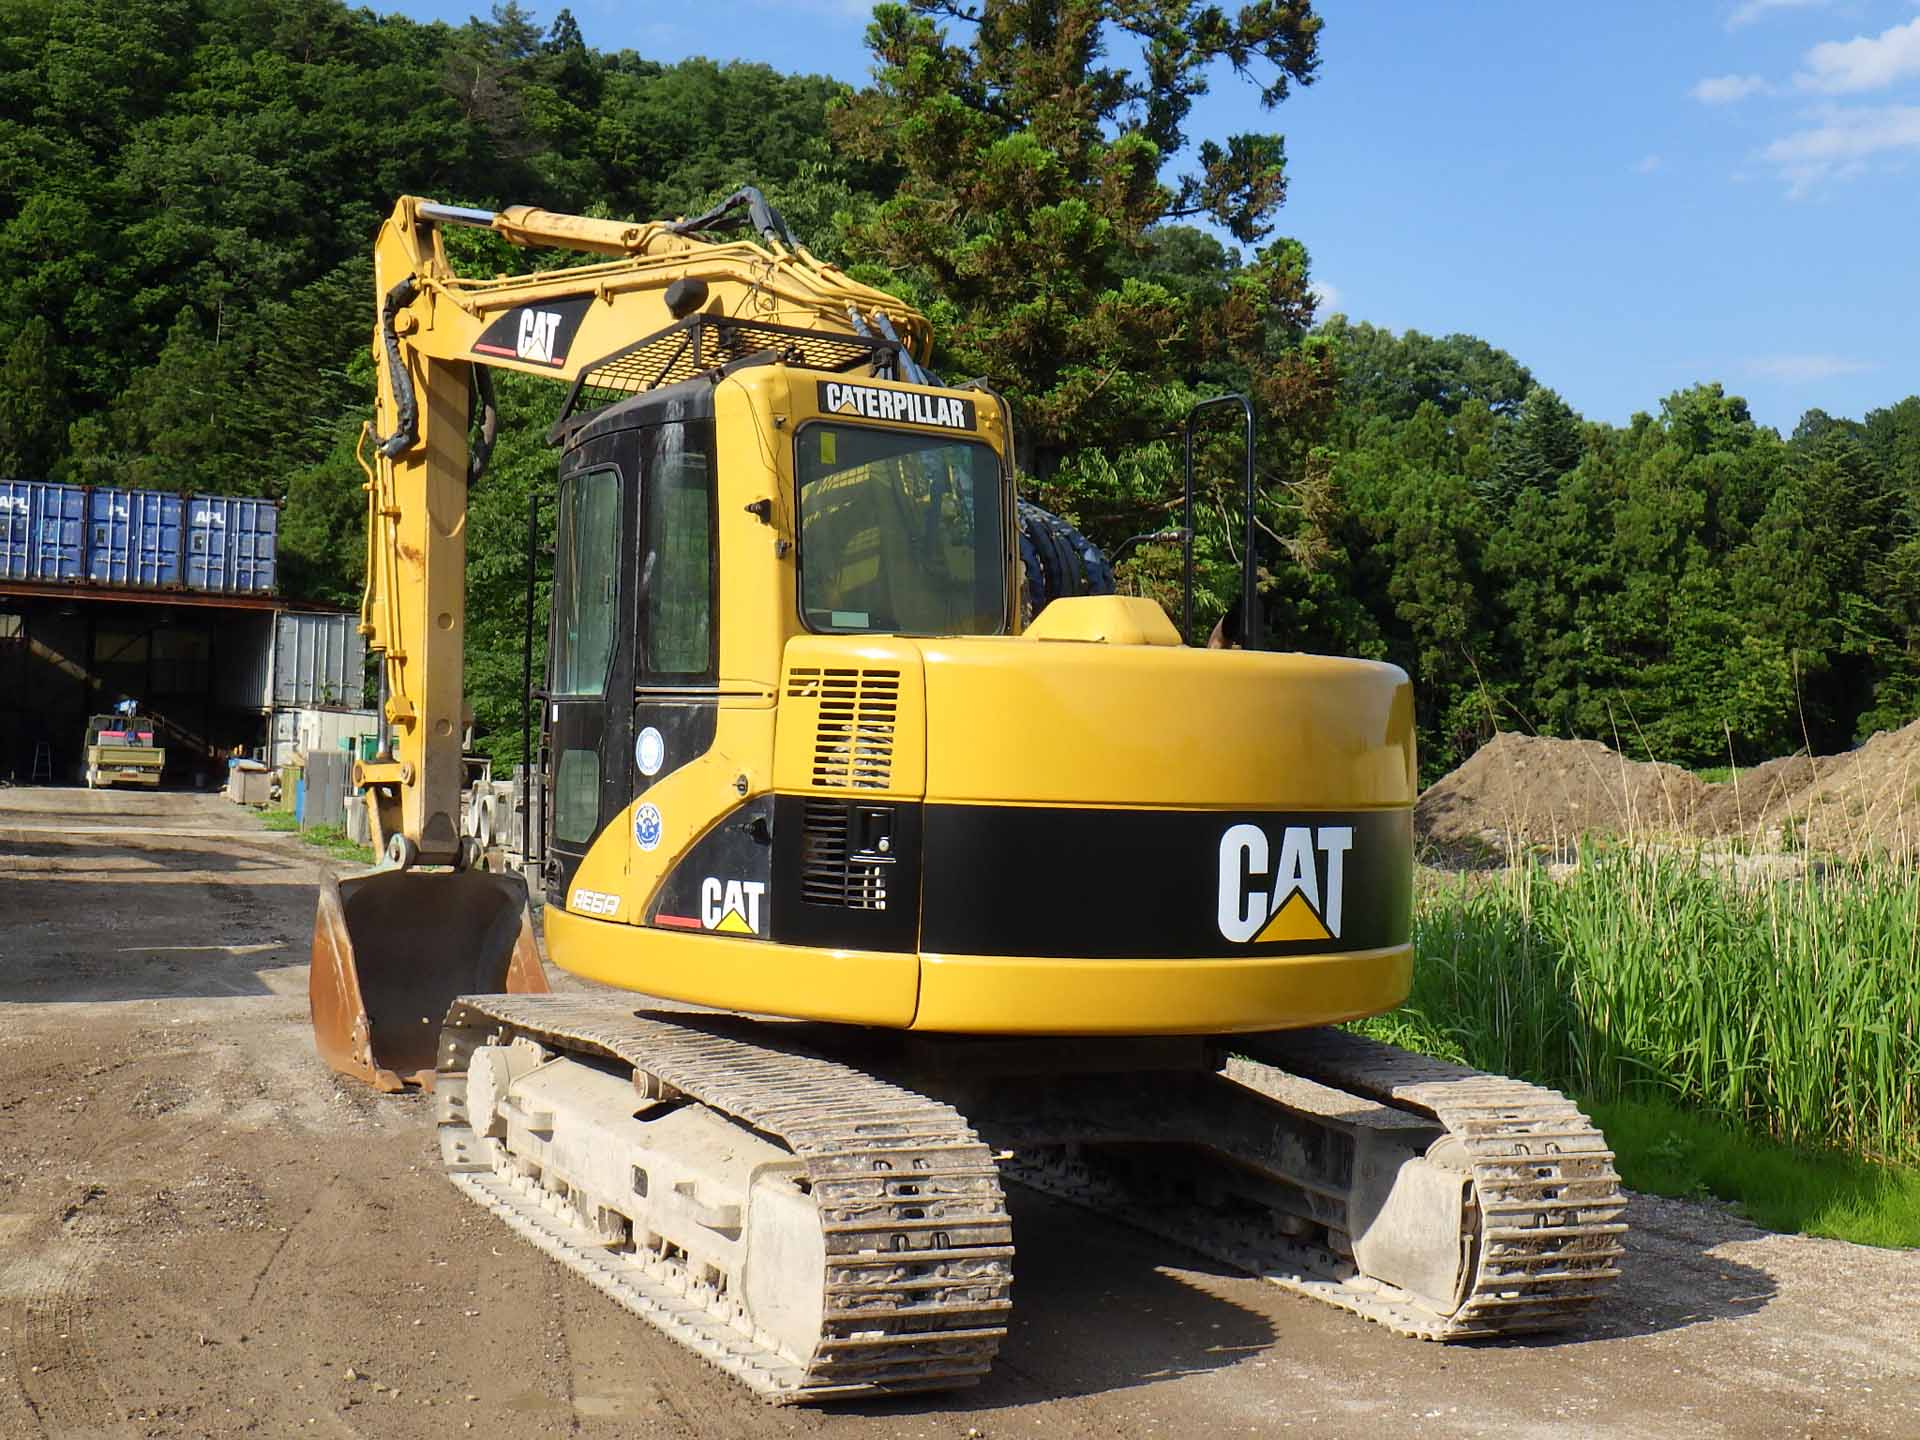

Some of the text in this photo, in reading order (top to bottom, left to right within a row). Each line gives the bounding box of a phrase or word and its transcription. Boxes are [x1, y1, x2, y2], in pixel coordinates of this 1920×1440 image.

[517, 308, 562, 363] CAT
[826, 383, 966, 428] CATERPILLAR
[195, 511, 225, 524] APL
[701, 876, 765, 935] CAT
[1218, 823, 1353, 943] CAT
